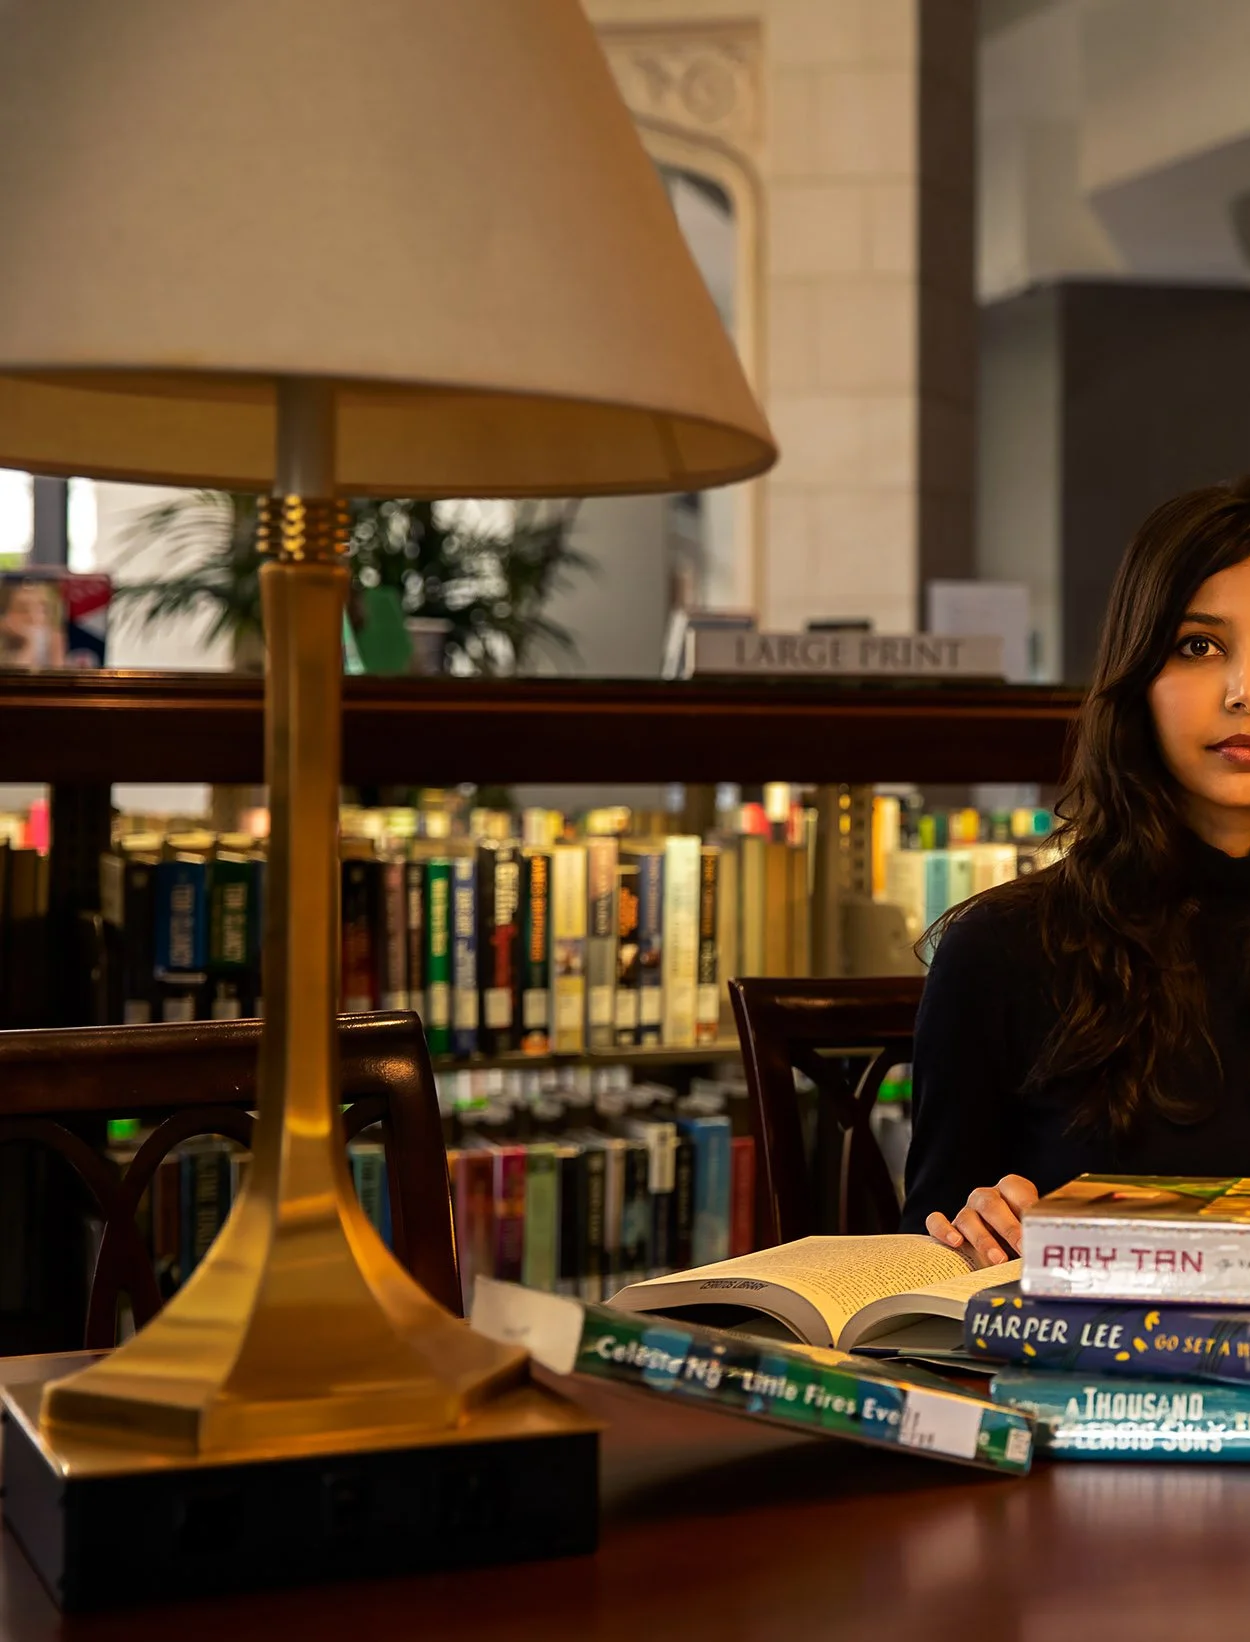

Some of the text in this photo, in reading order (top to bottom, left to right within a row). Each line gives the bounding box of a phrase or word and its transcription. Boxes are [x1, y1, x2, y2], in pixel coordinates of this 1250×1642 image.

[734, 635, 966, 669] LARGE PRINT
[1043, 1245, 1117, 1270] AMY
[1131, 1248, 1204, 1272] TAN
[971, 1312, 1069, 1344] HARPER
[1080, 1322, 1124, 1349] LEE
[1154, 1333, 1179, 1352] GO
[1182, 1335, 1216, 1354] SET
[1218, 1339, 1230, 1357] A
[684, 1355, 723, 1389] Ng
[742, 1370, 799, 1402] Little
[804, 1382, 857, 1416] Fires
[1083, 1386, 1204, 1421] THOUSAND
